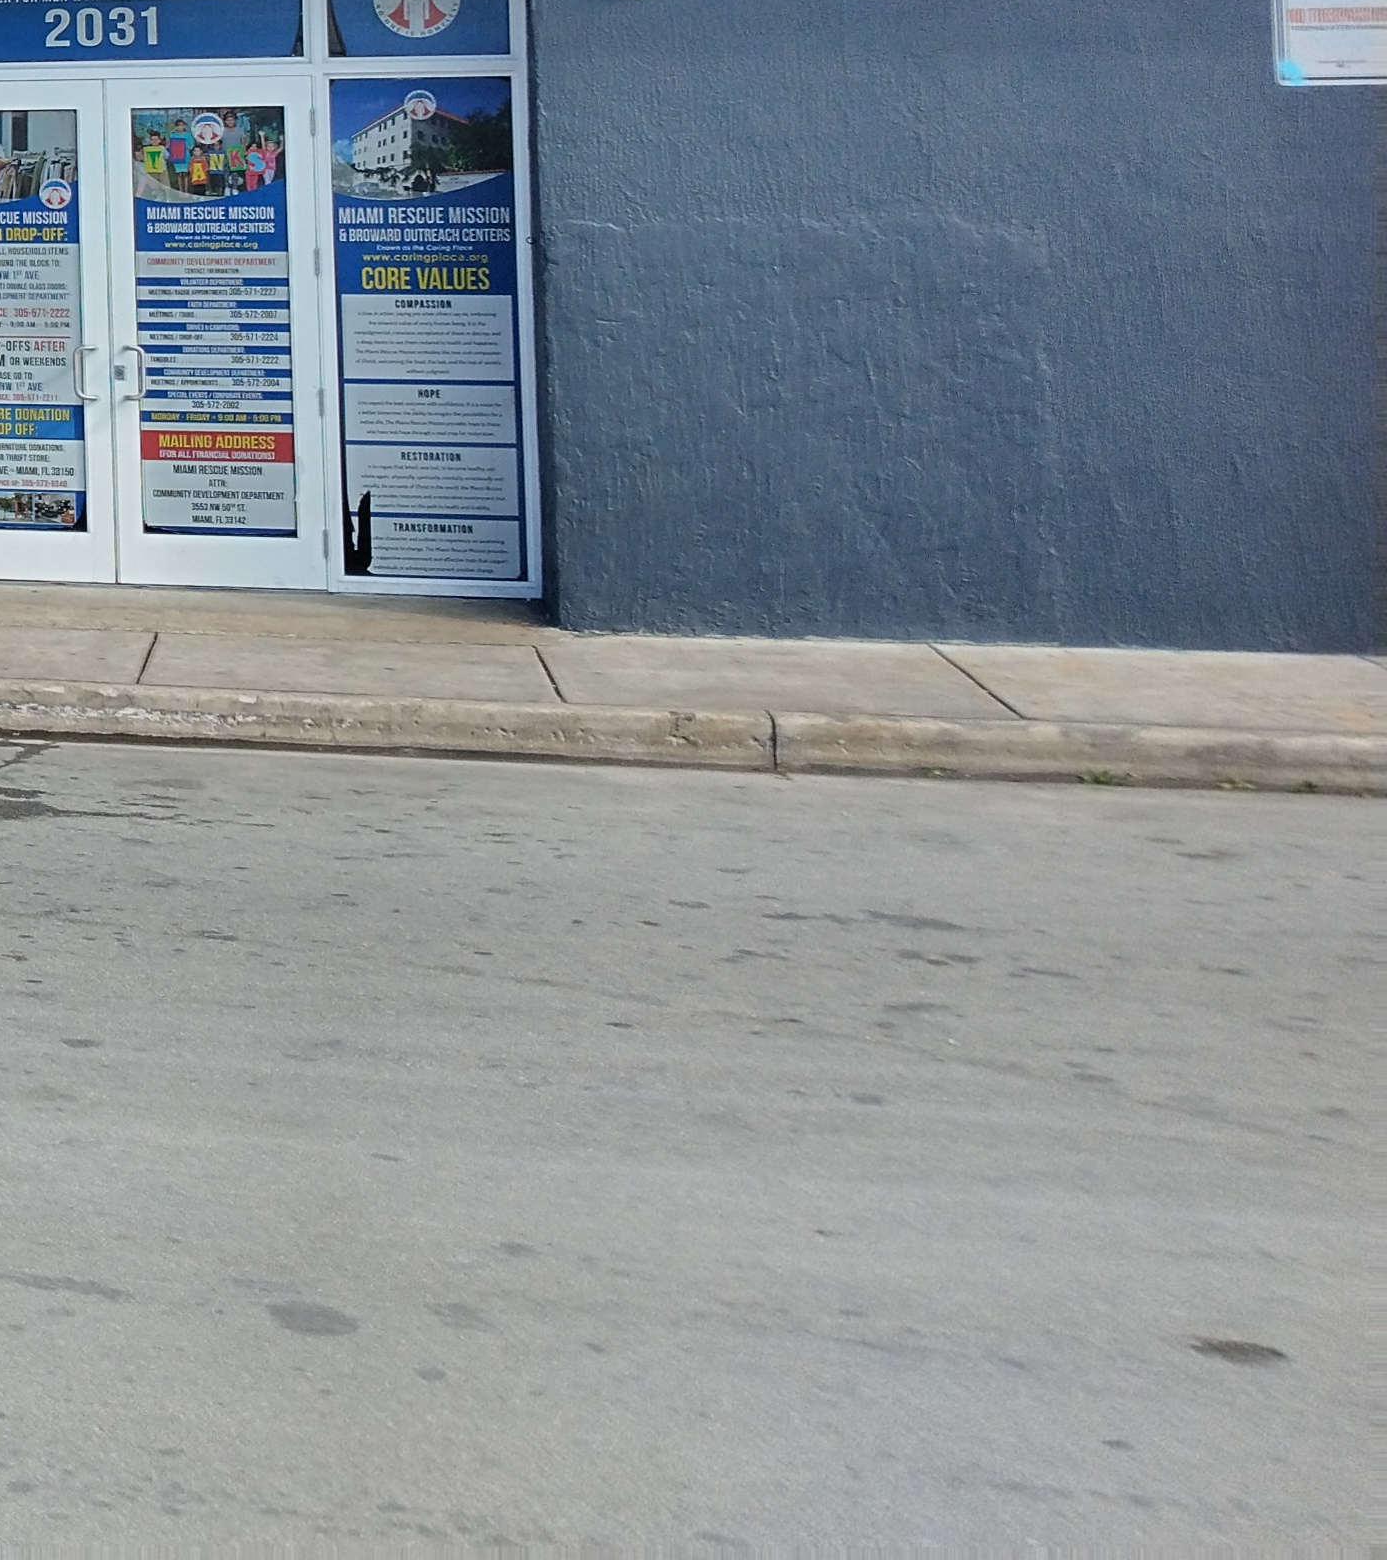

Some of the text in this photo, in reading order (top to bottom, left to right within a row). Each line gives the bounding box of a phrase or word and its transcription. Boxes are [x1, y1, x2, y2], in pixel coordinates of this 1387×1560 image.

[45, 6, 158, 47] 2031
[23, 211, 67, 224] MISSION
[147, 207, 275, 220] MIAMI RESCUE MISSION
[339, 207, 510, 224] MIAMI RESCUE MISSION
[147, 223, 275, 233] & BROWARD OUTREACH CENTERS
[6, 228, 68, 241] DROP-OFF:
[339, 228, 511, 242] & BROWARD OUTREACH CENTERS
[48, 247, 69, 255] ITEMS
[16, 259, 27, 267] THE
[362, 253, 488, 263] www.caringplace.org
[25, 271, 39, 279] AVE
[361, 267, 490, 290] CORE VALUES
[395, 300, 452, 308] COMPASSION
[33, 341, 65, 351] AFTER
[9, 357, 20, 366] OR
[0, 382, 12, 390] NW
[28, 382, 42, 391] AVE
[417, 389, 441, 399] HOPE
[15, 408, 69, 421] DONATION
[159, 434, 275, 449] MAILING ADDRESS
[400, 452, 462, 462] RESTORATION
[173, 465, 262, 475] MIAMI RESCUE MISSION
[153, 490, 284, 500] COMMUNITY DEVELOPMENT DEPARTMENT
[210, 503, 220, 511] NW
[392, 523, 474, 534] TRANSFORMATION
